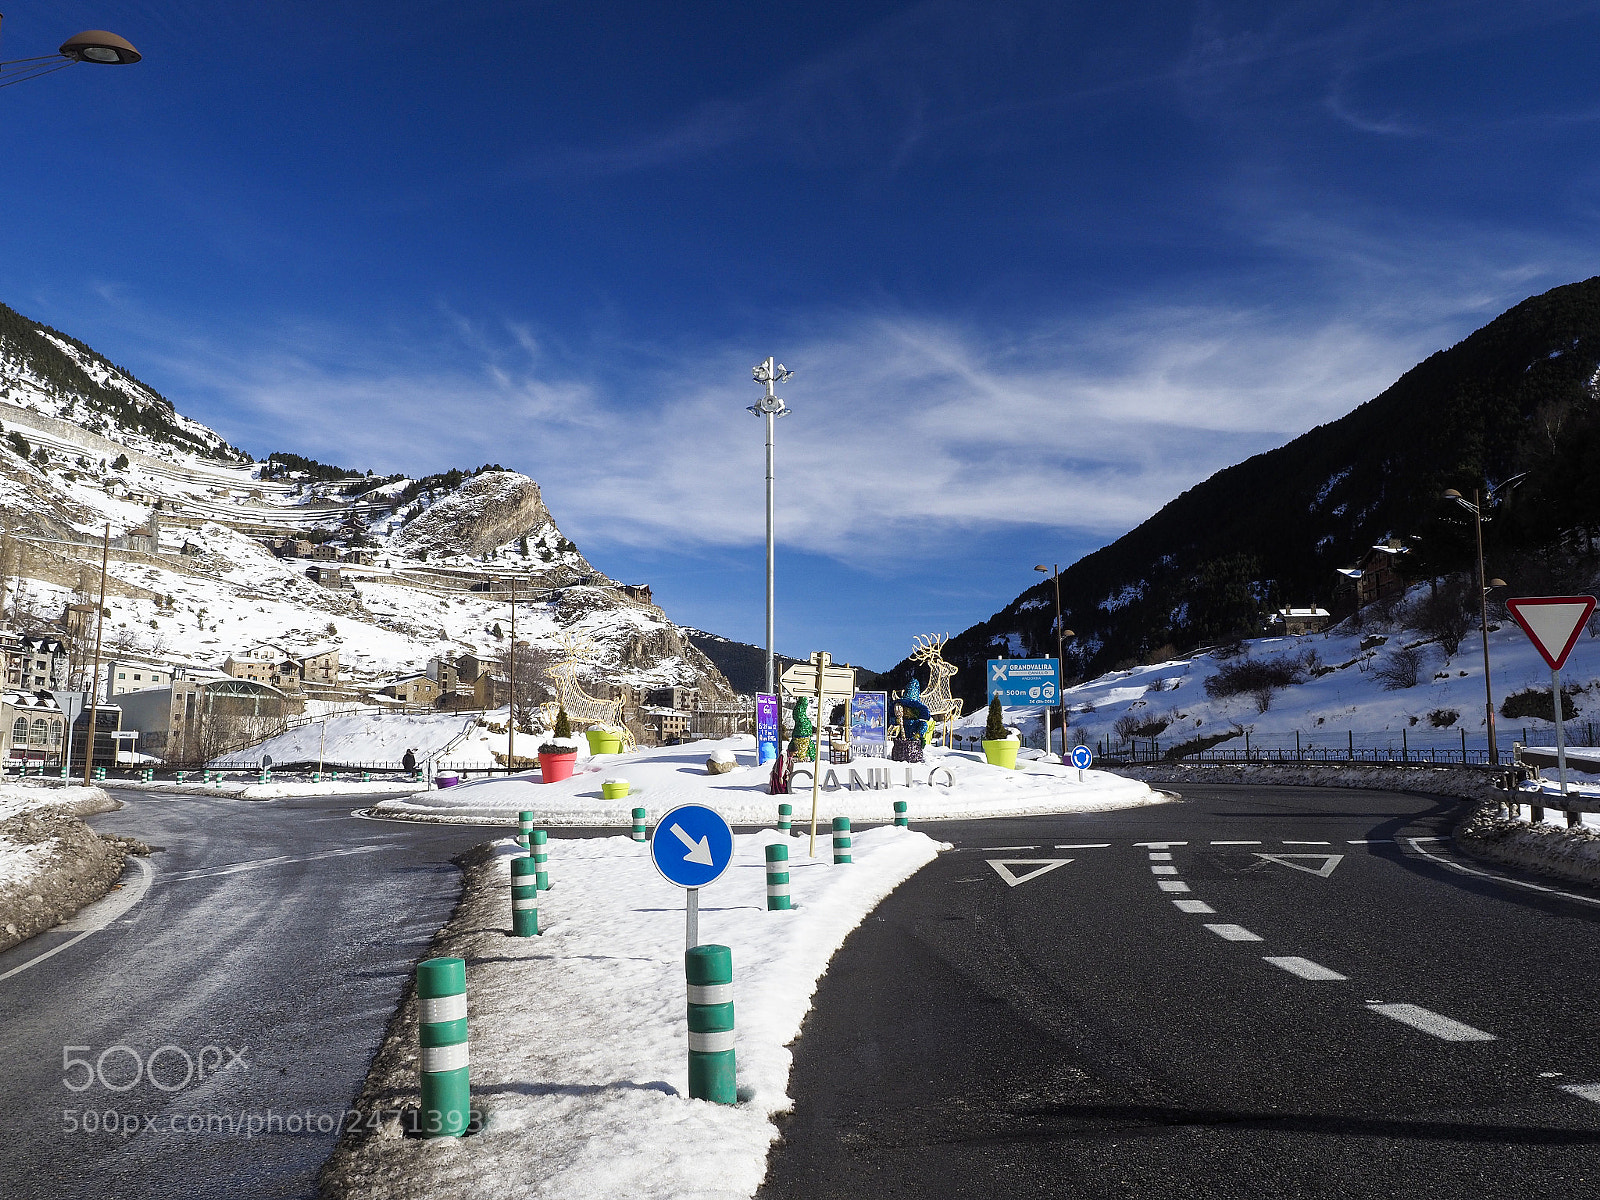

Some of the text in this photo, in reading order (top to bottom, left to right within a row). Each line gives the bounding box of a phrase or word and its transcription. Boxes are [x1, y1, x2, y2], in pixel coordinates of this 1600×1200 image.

[852, 744, 863, 754] Del
[864, 744, 869, 754] 7
[876, 744, 884, 754] 12
[787, 766, 956, 794] CANILLO
